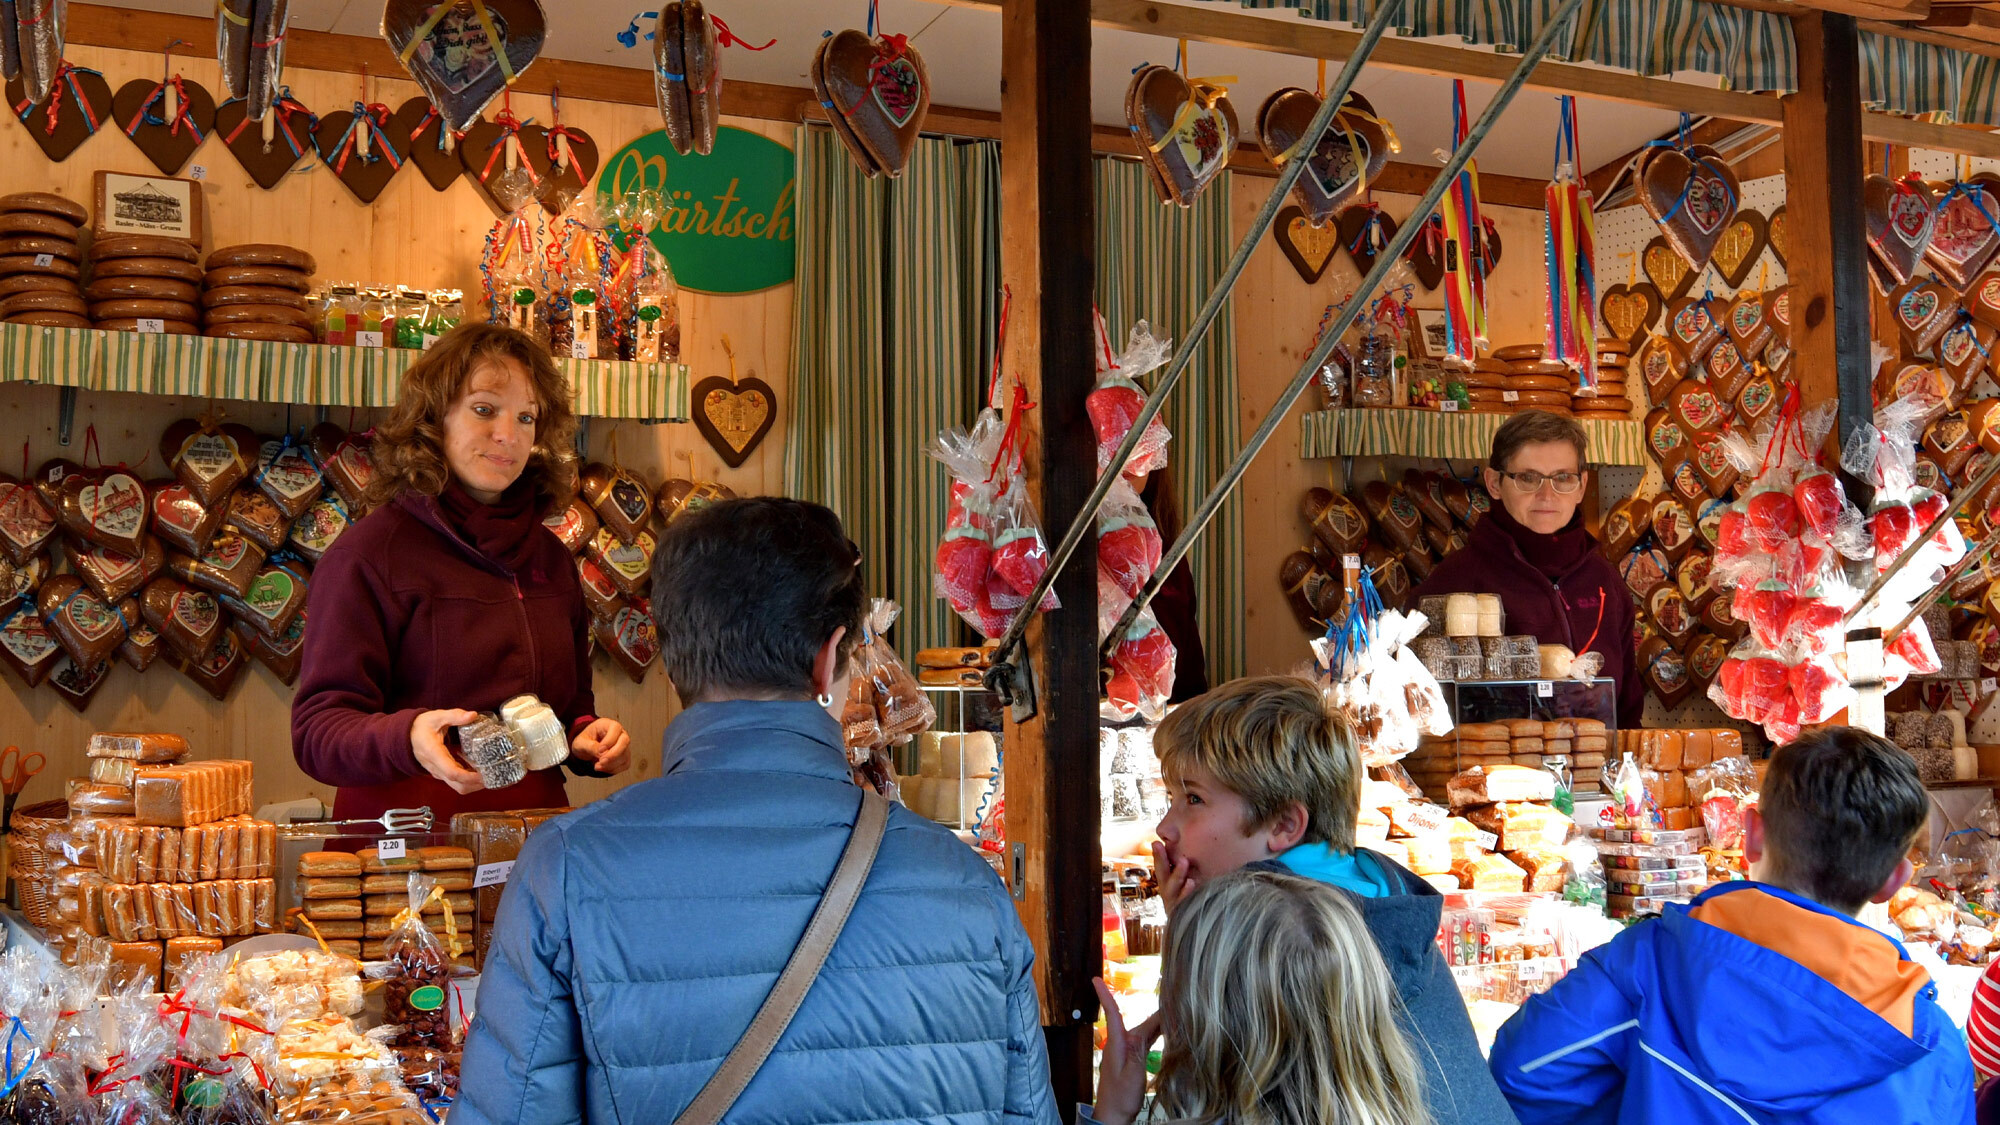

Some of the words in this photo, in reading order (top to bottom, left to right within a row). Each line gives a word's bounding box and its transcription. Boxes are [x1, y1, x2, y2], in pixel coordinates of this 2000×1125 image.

[612, 148, 795, 241] Bärtsch
[1408, 812, 1440, 831] Dijoner
[383, 841, 399, 850] 2.20
